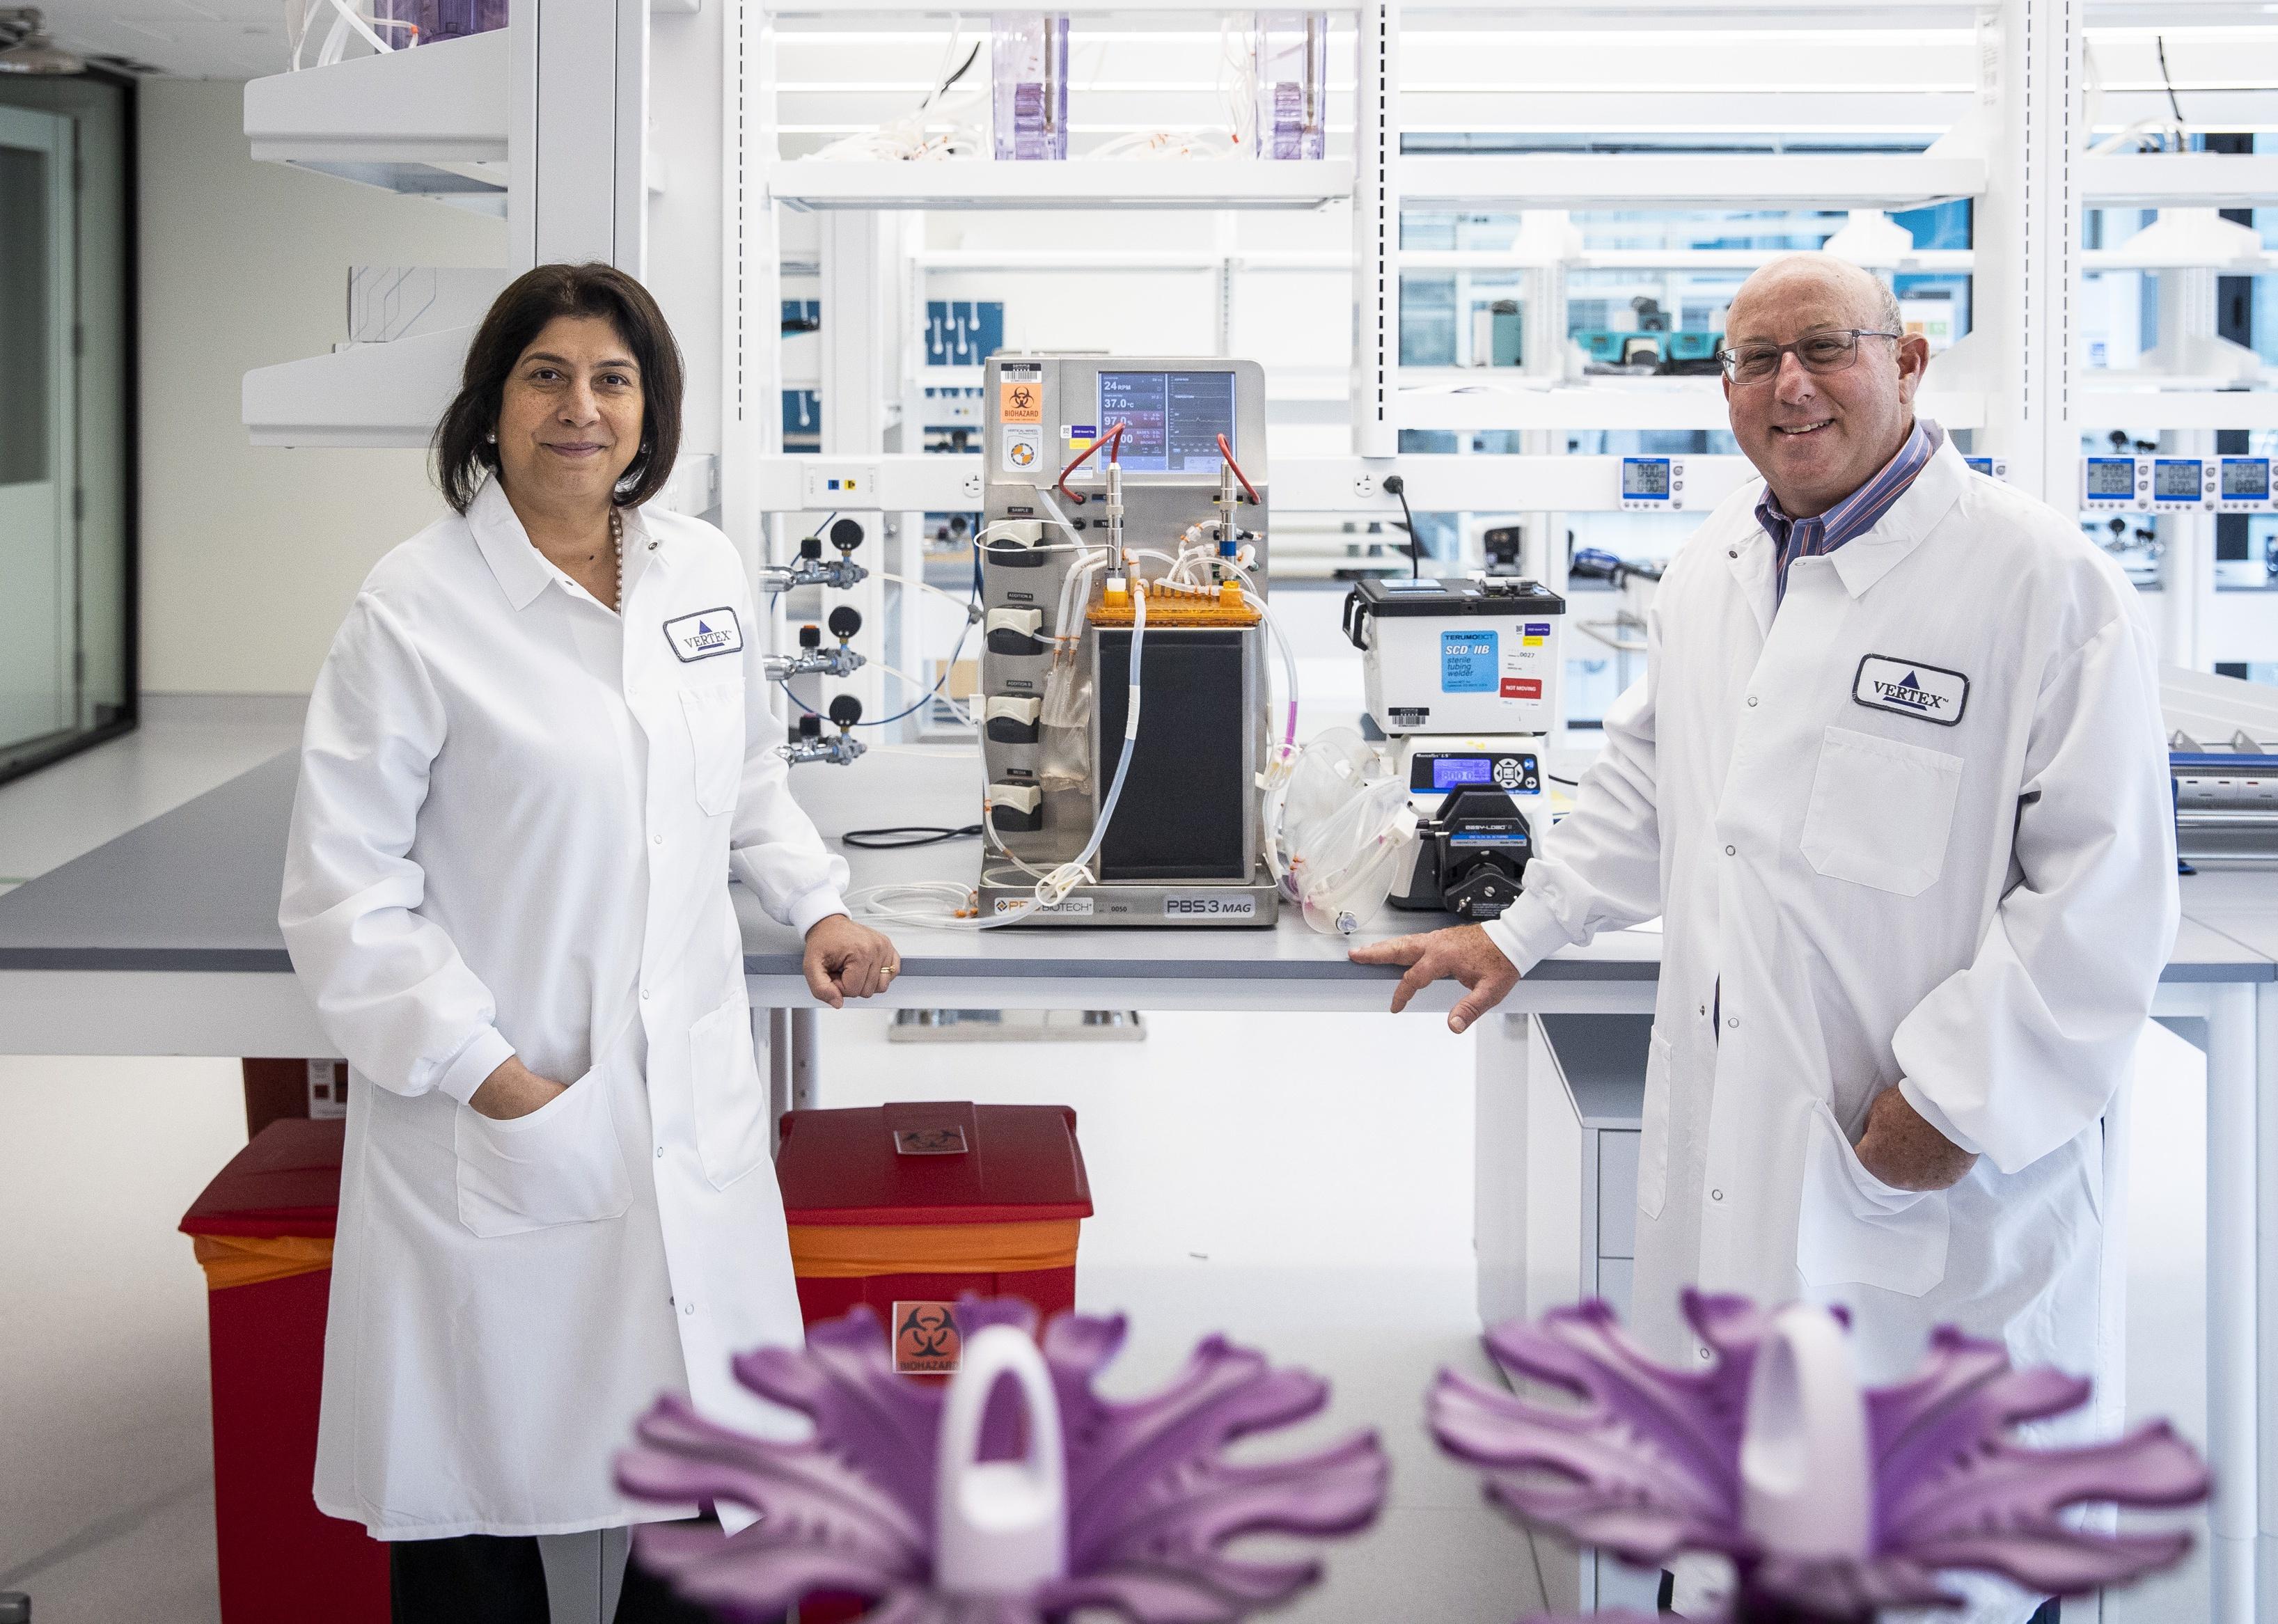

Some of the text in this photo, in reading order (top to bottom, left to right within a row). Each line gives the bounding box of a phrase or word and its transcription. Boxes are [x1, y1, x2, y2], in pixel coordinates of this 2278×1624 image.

[1104, 381, 1117, 390] 24
[1104, 399, 1126, 408] 37.0
[1167, 900, 1252, 913] PBS 3 MAG
